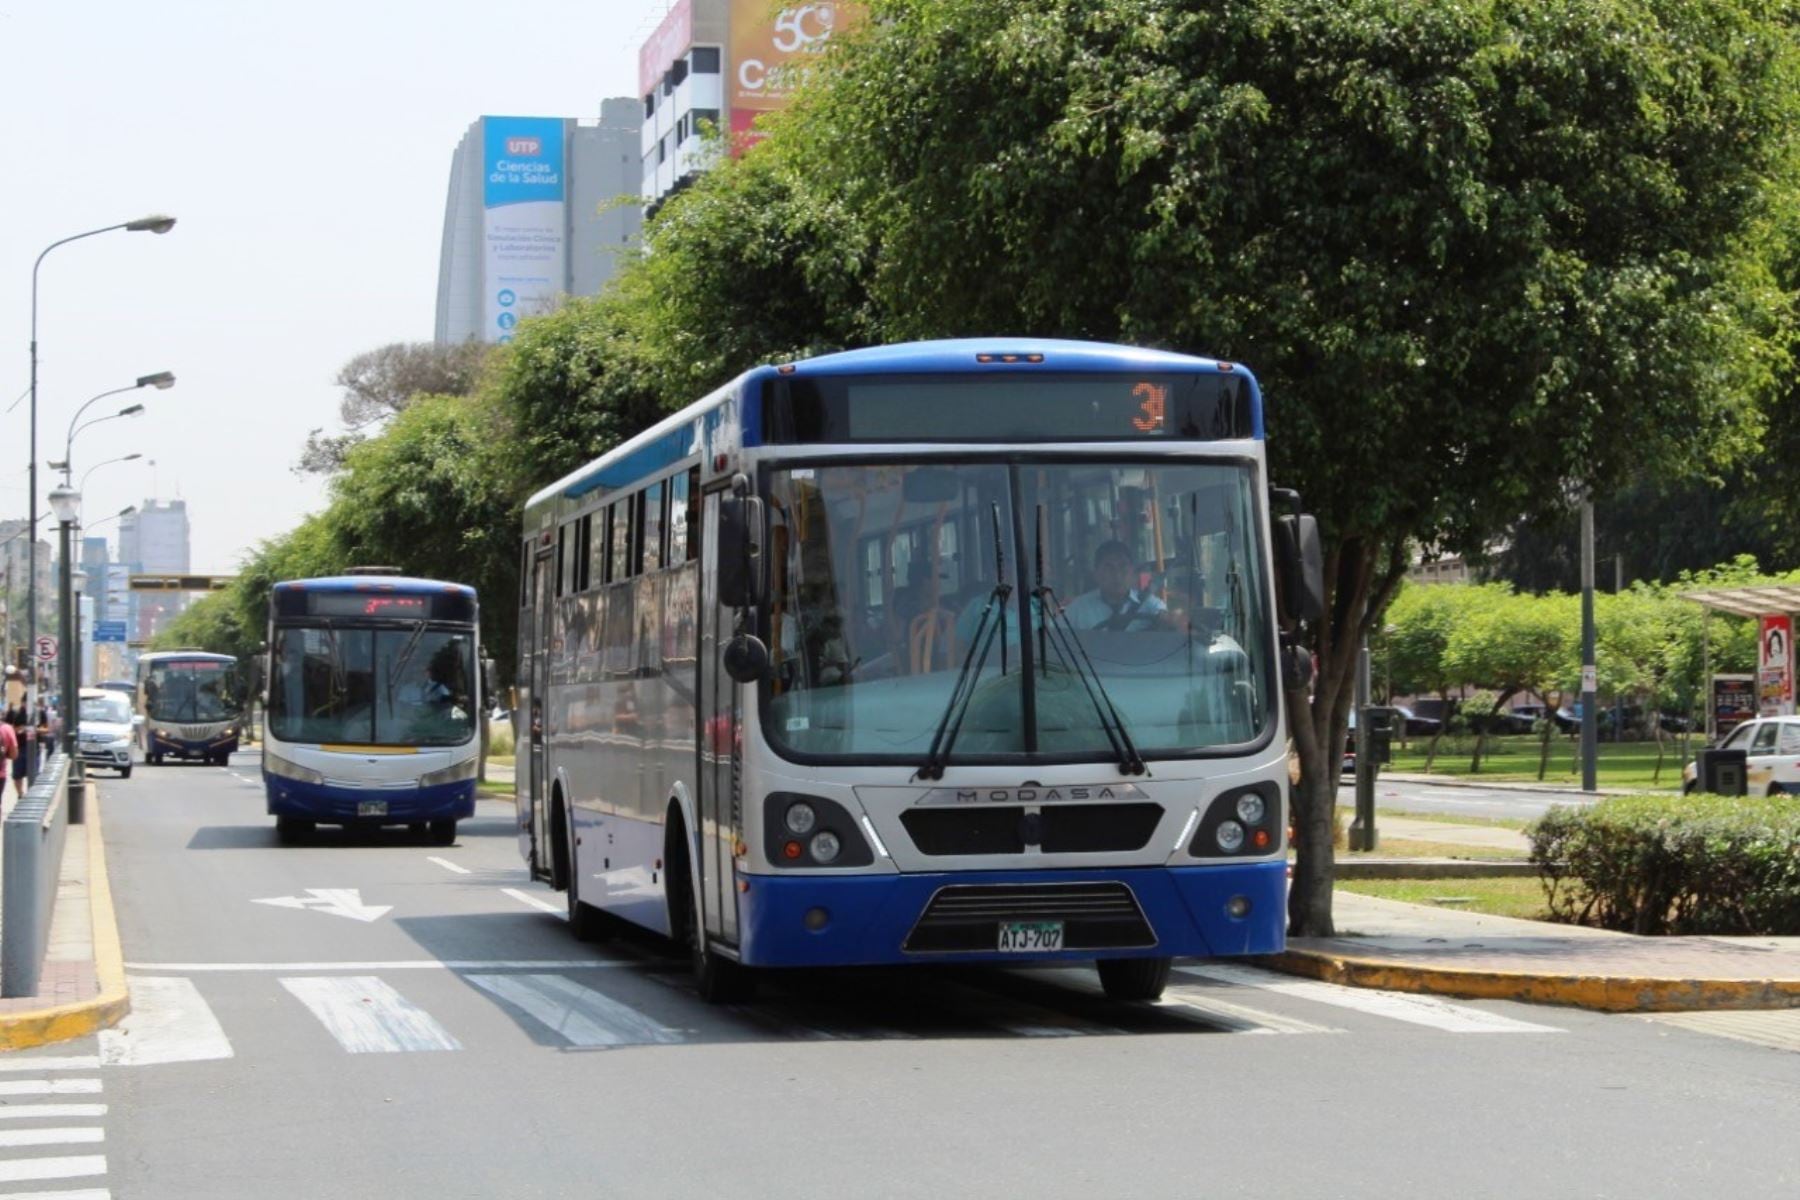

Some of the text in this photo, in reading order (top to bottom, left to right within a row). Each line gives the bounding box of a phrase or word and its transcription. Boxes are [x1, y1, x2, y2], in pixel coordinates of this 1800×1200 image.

[508, 140, 539, 154] UTP
[496, 160, 552, 173] Ciencias
[489, 172, 559, 184] de la Salud
[956, 788, 1115, 802] MODASA
[1000, 929, 1061, 948] ATJ-707
